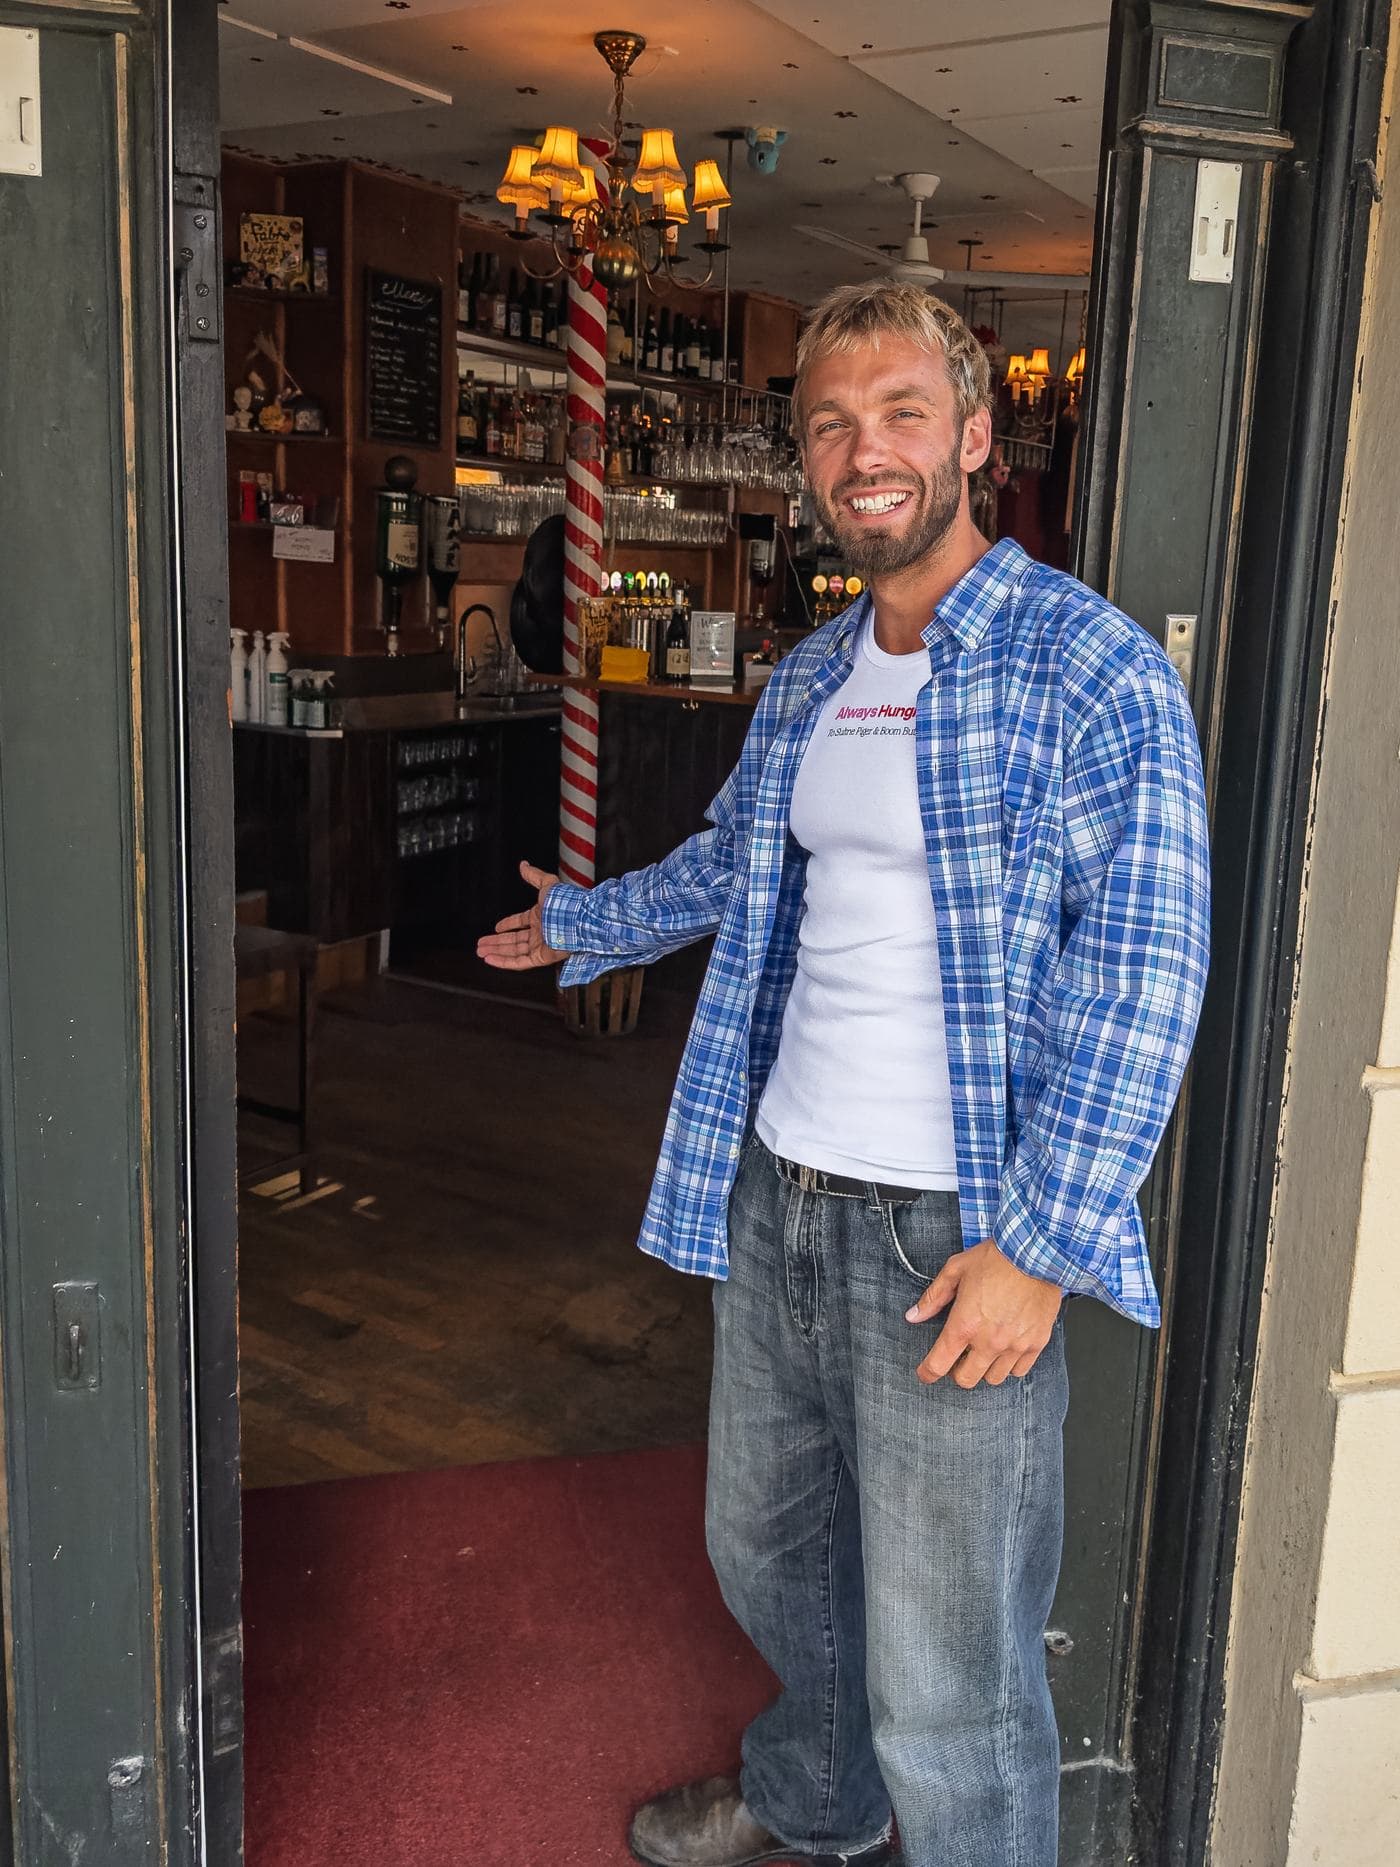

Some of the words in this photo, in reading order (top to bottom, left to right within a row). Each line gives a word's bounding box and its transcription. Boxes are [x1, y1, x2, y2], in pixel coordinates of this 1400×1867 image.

[835, 706, 878, 721] Always
[855, 726, 873, 738] Piger
[879, 726, 901, 736] Boom
